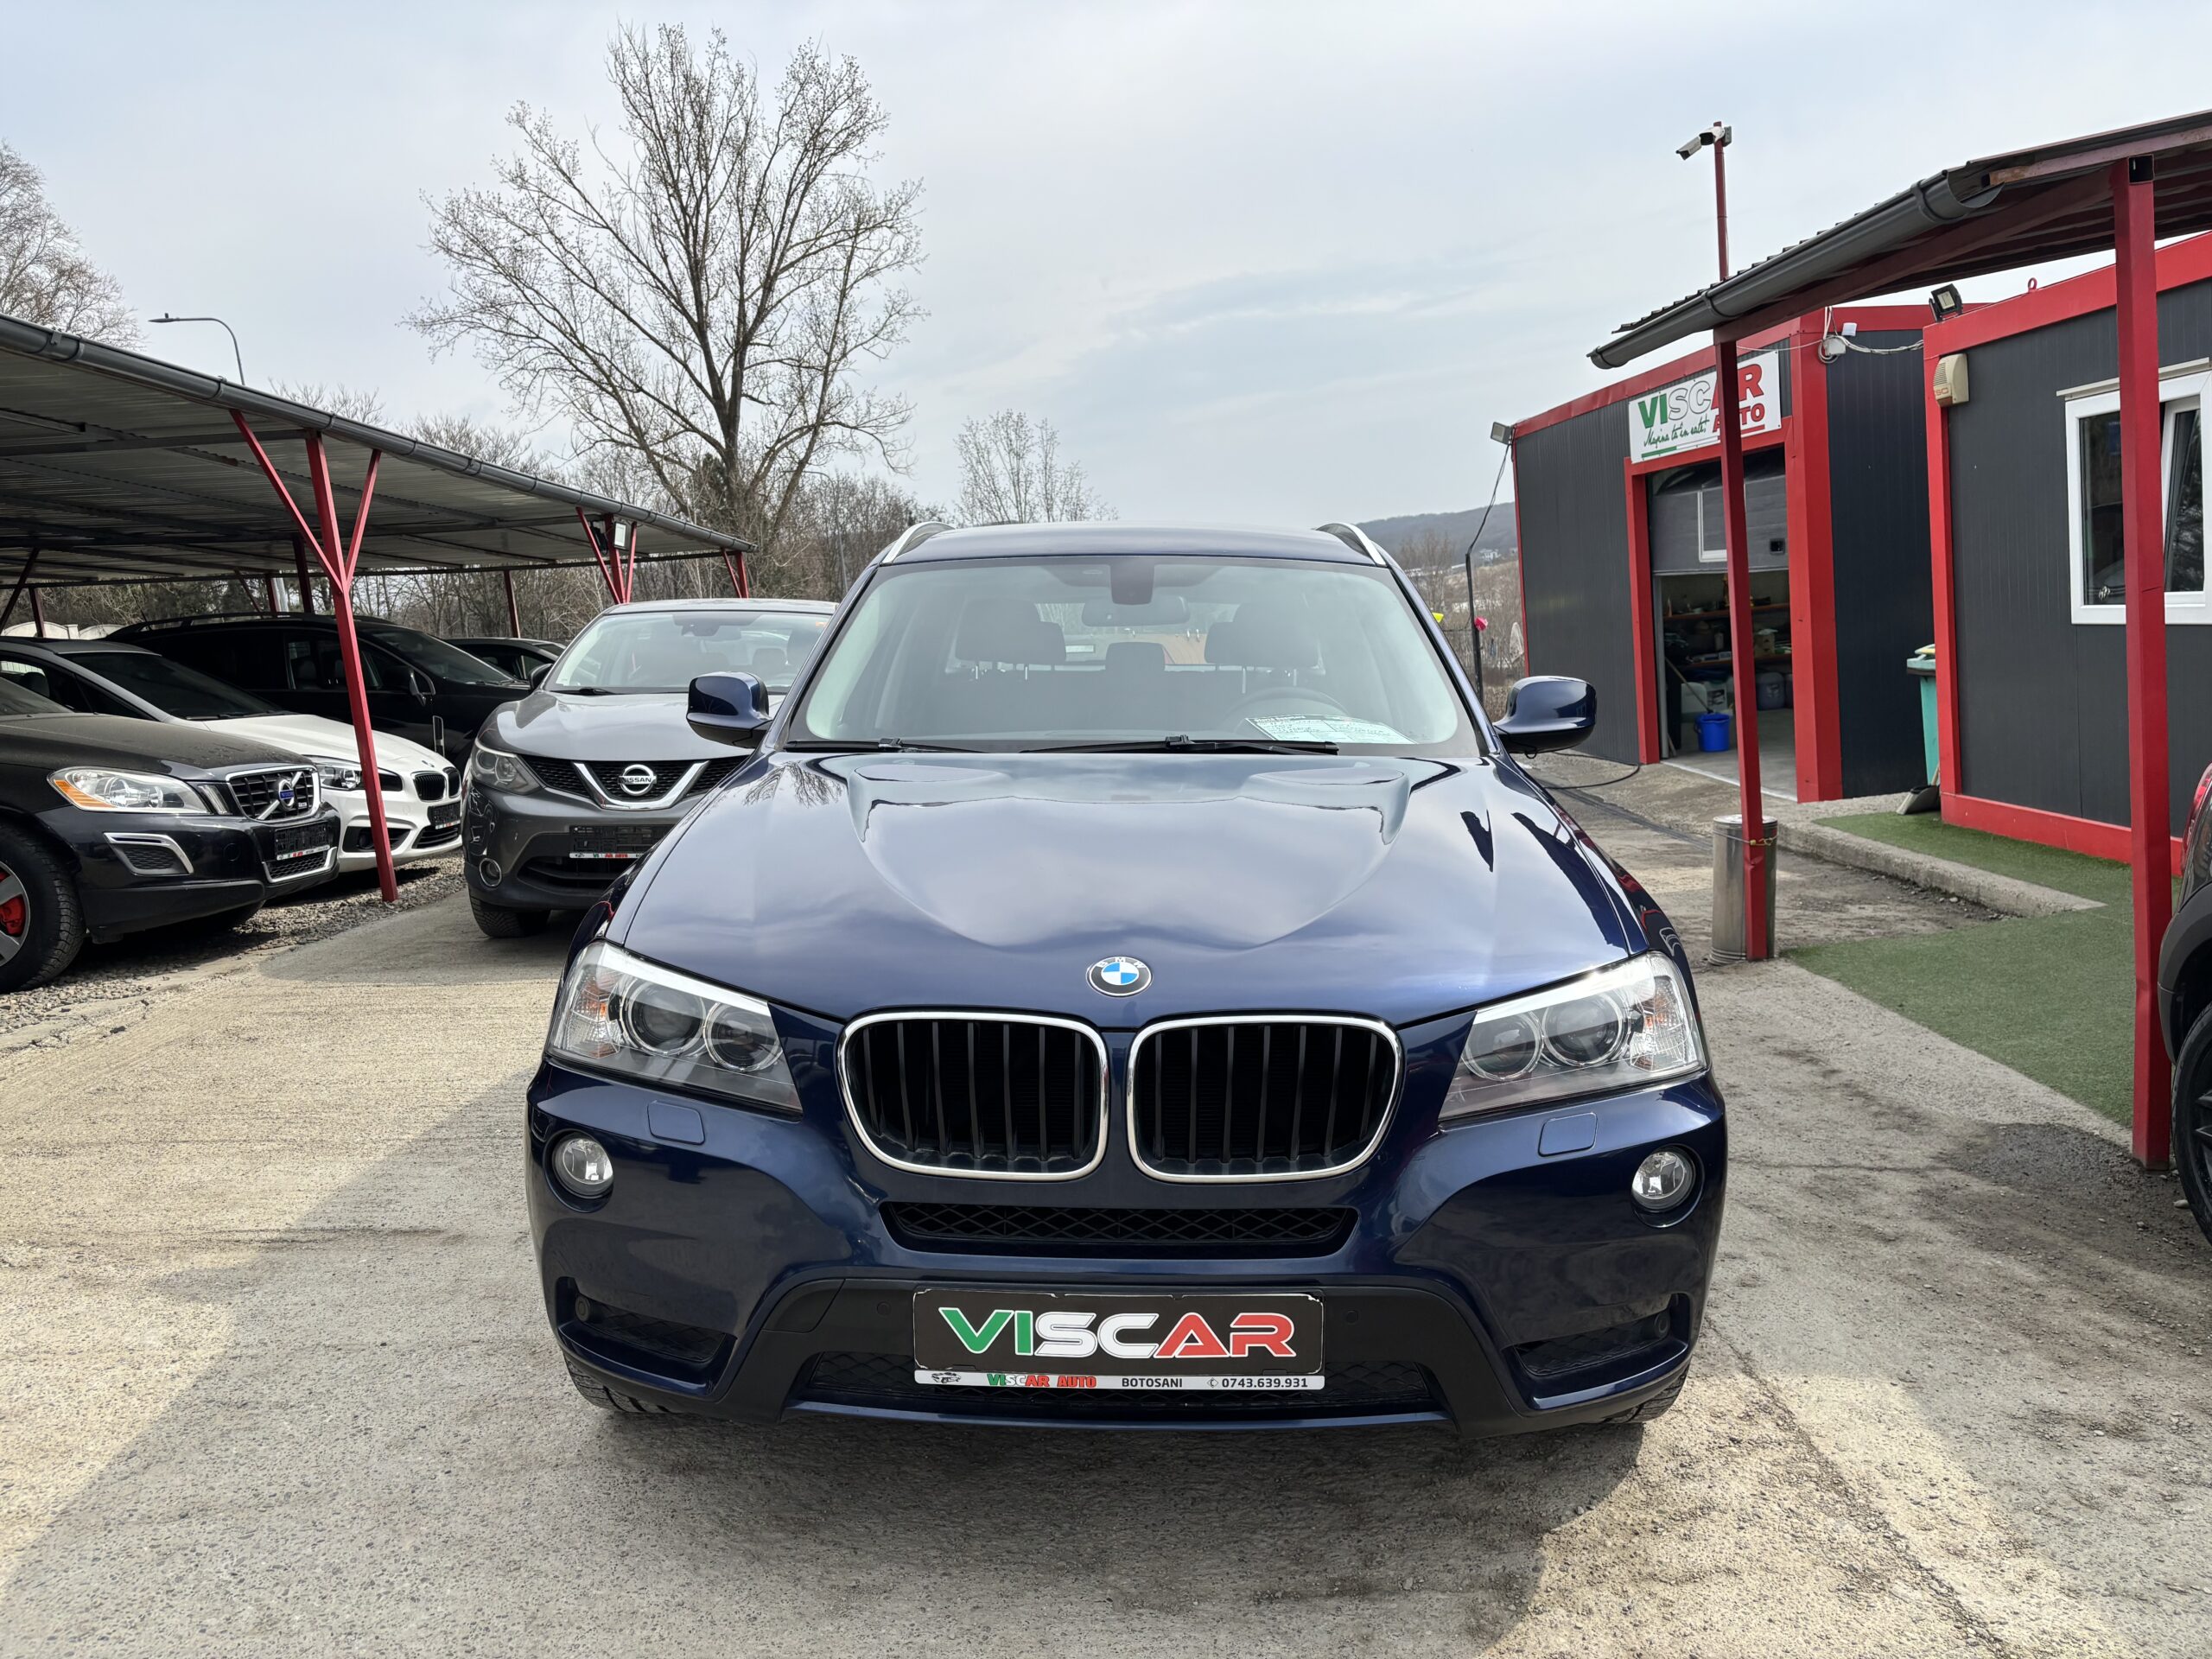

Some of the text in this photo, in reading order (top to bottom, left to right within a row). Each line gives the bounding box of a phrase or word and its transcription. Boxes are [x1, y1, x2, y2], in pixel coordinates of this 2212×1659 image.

[1712, 402, 1765, 434] ATO
[1095, 957, 1147, 969] BMW
[938, 1306, 1297, 1359] VISCAR
[986, 1373, 1308, 1389] VISCAR AUTO BOTOSANI 0743.639.931
